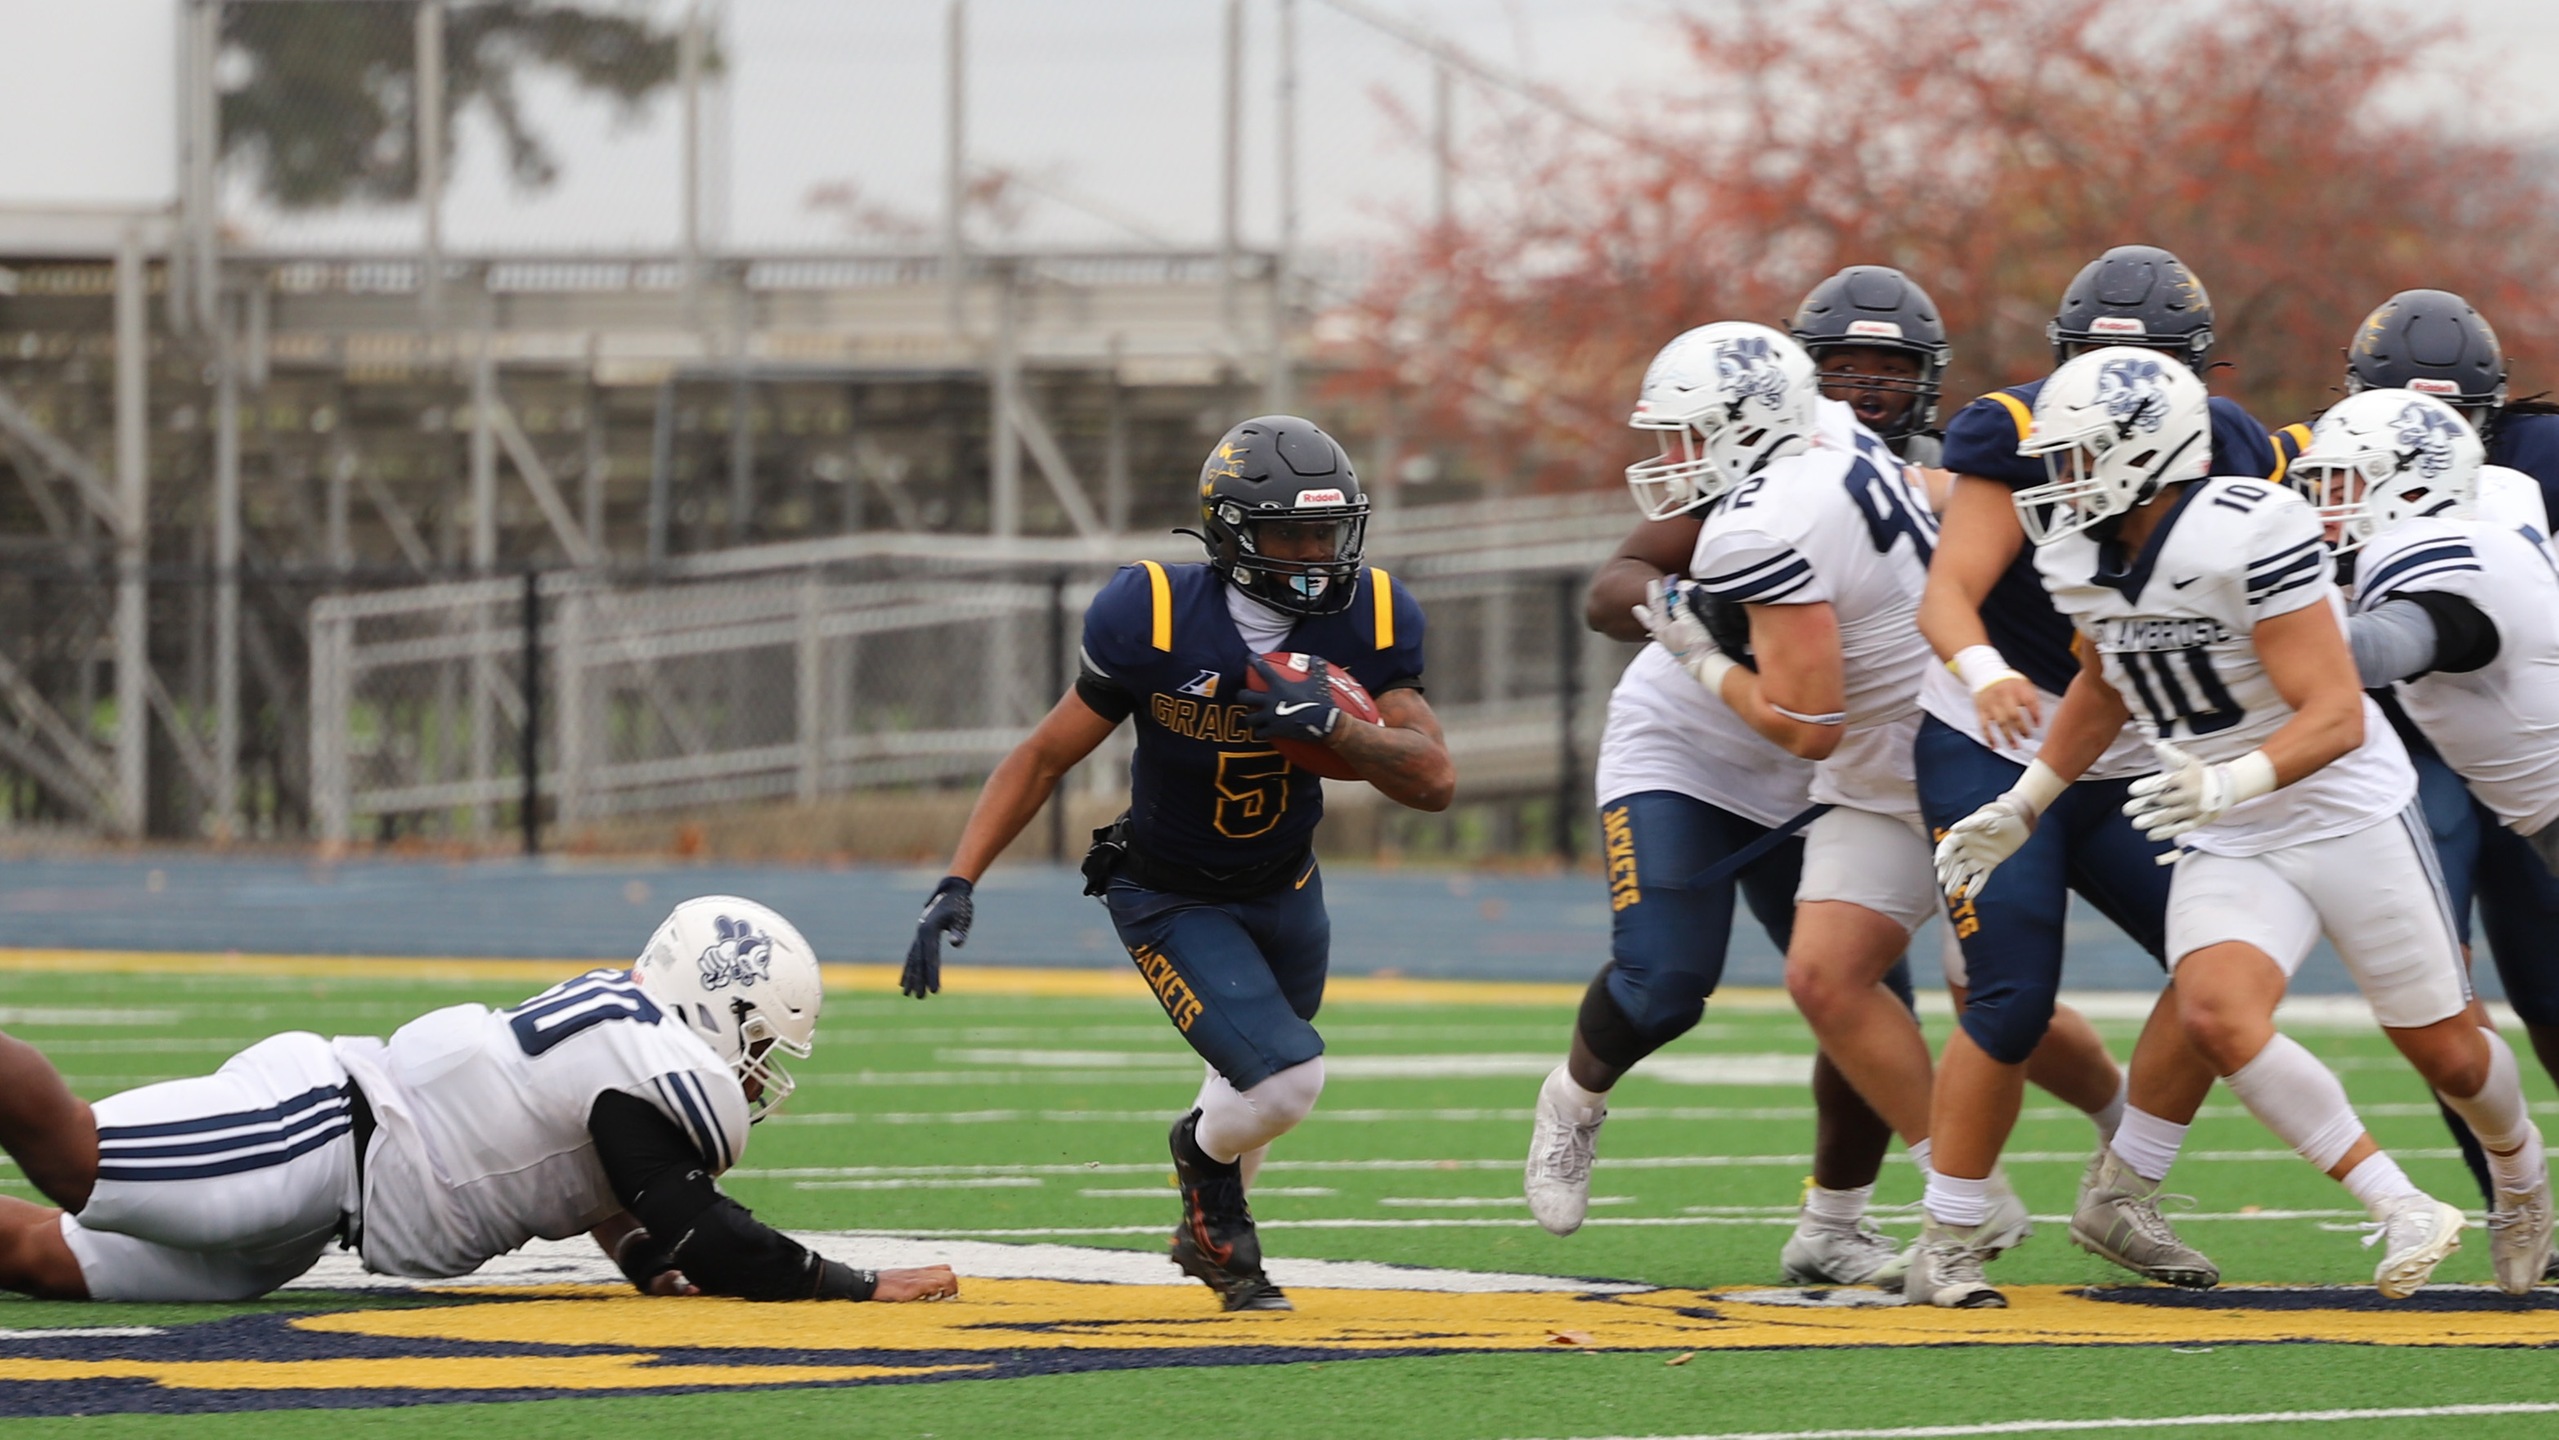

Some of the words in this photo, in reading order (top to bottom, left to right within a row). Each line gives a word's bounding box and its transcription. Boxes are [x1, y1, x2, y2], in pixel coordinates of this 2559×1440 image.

[1303, 493, 1341, 503] Riddell
[2214, 485, 2269, 513] 10
[2117, 647, 2246, 739] 10
[1213, 750, 1291, 839] 5
[1127, 943, 1204, 1032] JACKETS
